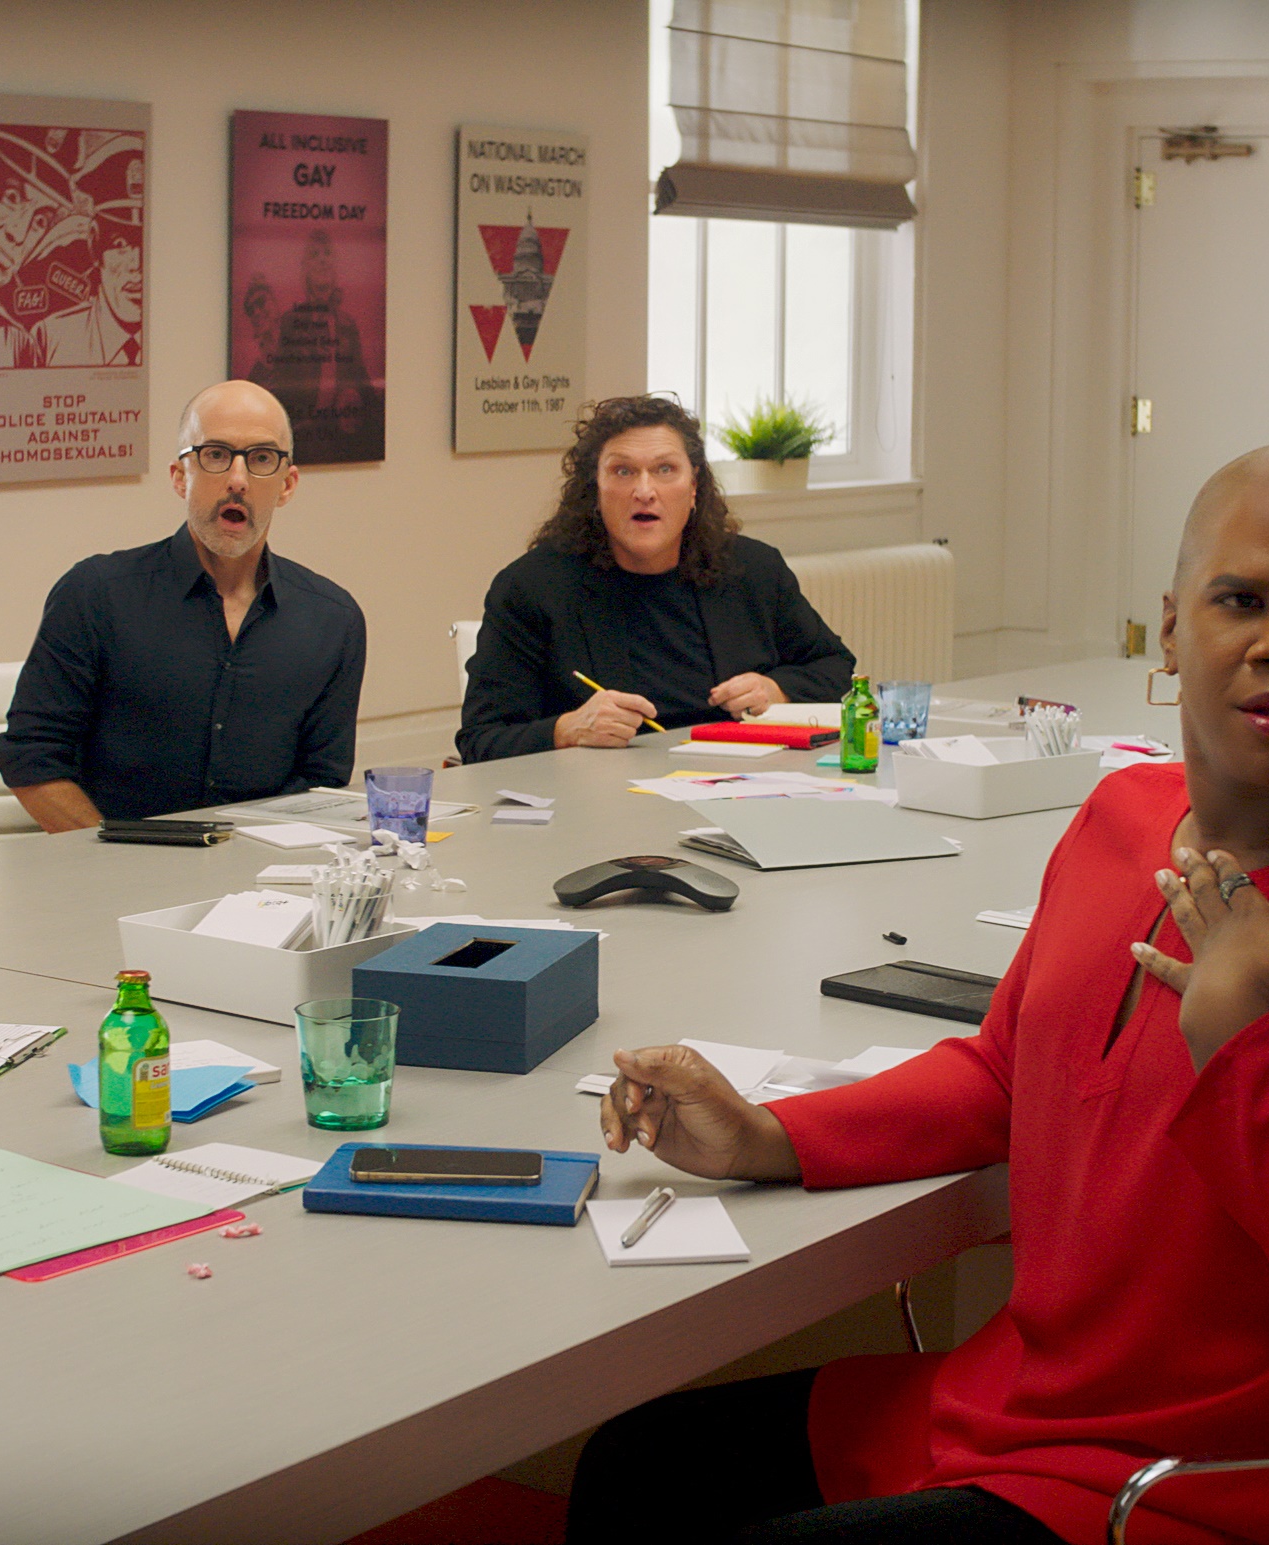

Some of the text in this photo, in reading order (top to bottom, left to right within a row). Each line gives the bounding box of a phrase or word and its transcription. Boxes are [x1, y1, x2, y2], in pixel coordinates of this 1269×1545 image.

[259, 132, 368, 154] ALL INCLUSIVE
[467, 140, 585, 166] NATIONAL MARCH
[294, 163, 337, 188] GAY
[470, 174, 583, 198] ON WASHINGTON
[263, 203, 366, 222] FREEDOM DAY
[475, 375, 570, 391] Lesbian & Gay Rights
[43, 394, 86, 408] STOP
[482, 398, 564, 415] October 11th, 1987
[55, 409, 141, 427] BRUTALITY
[27, 429, 100, 445] AGAINST
[0, 443, 133, 464] HOMOSEXUALS!
